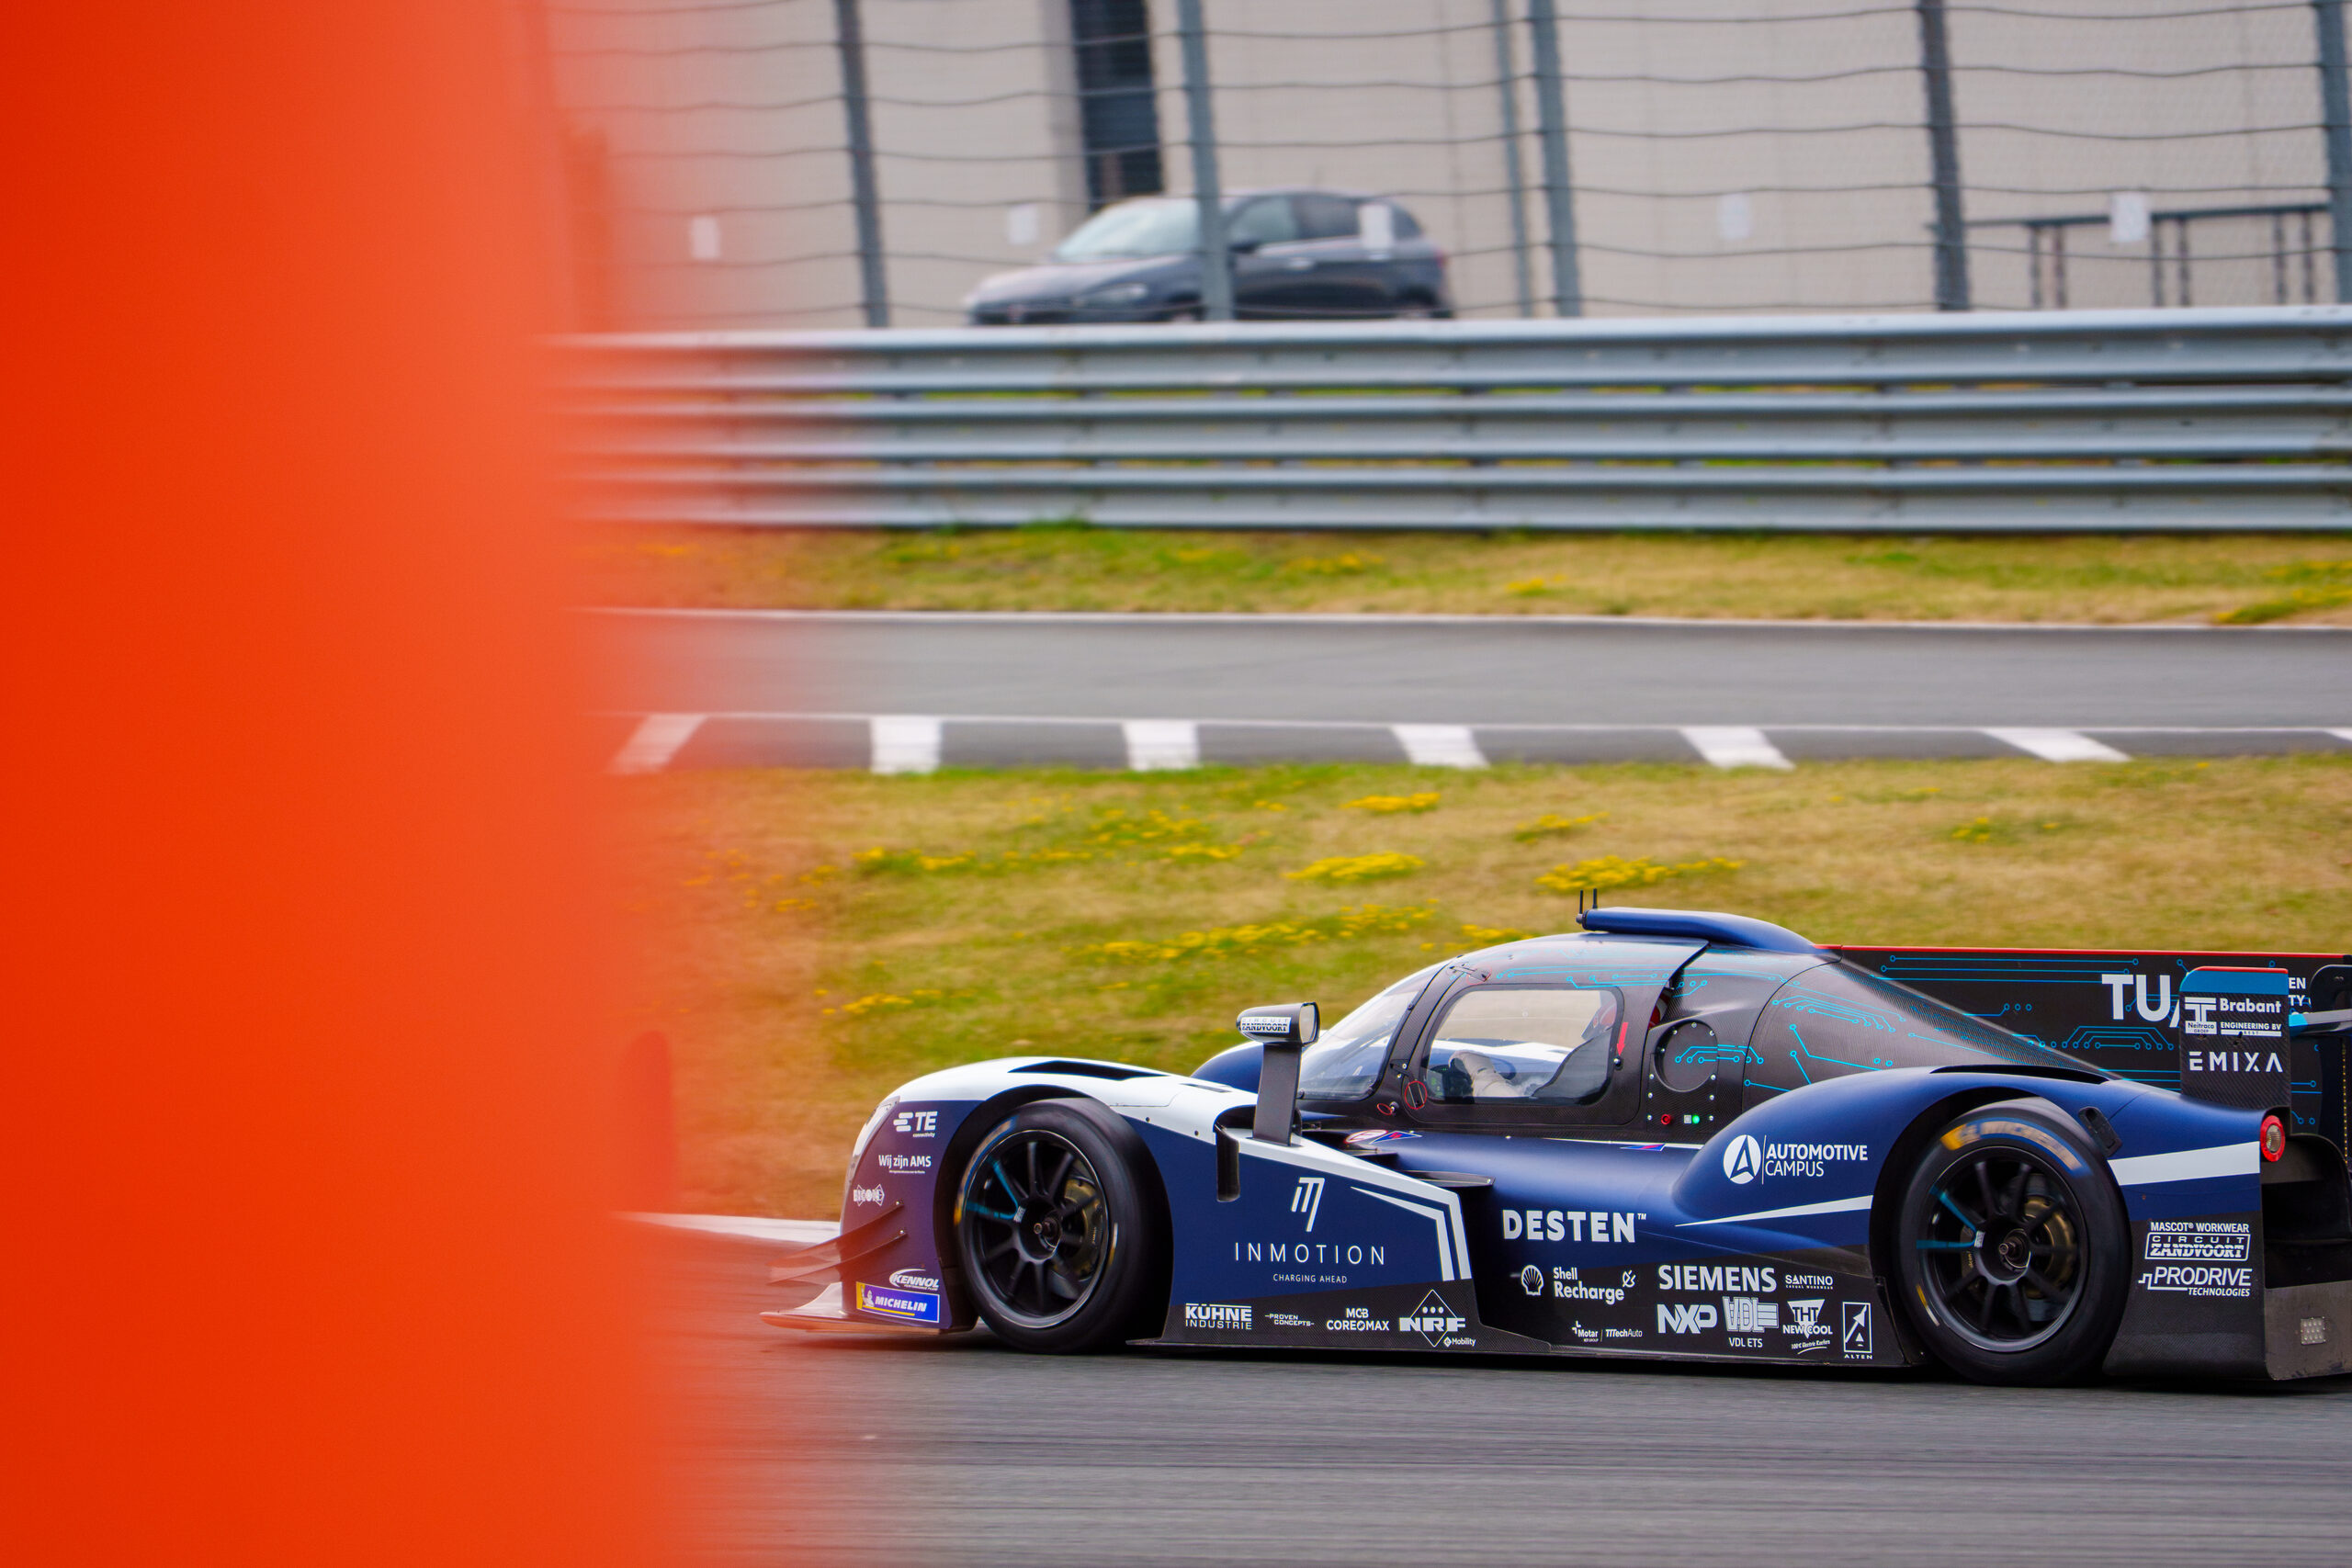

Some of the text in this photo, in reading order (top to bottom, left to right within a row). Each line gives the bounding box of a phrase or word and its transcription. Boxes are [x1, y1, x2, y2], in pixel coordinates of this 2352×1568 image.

[2220, 998, 2281, 1013] Brabant
[2220, 1021, 2269, 1030] ENGINEERING
[2188, 1051, 2283, 1073] EMIXA
[914, 1111, 938, 1132] TE
[1765, 1144, 1869, 1161] AUTOMOTIVE
[878, 1154, 932, 1169] Wij zijn AMS
[1764, 1160, 1825, 1177] CAMPUS
[2195, 1223, 2250, 1233] WORKWEAR
[2152, 1235, 2245, 1244] CIRCUIT
[1235, 1242, 1385, 1265] INMOTION
[2150, 1243, 2245, 1258] ZANDVOORT
[891, 1274, 939, 1288] KENNOL
[1272, 1273, 1348, 1283] CHARGING AHEAD
[1553, 1267, 1577, 1280] Shell
[1657, 1264, 1778, 1293] SIEMENS
[1785, 1274, 1834, 1286] SANTINO
[2154, 1267, 2253, 1286] PRODRIVE
[1555, 1280, 1624, 1305] Recharge
[2188, 1288, 2251, 1297] TECHNOLOGIES
[875, 1296, 928, 1313] MICHELIN
[1346, 1308, 1369, 1319] MCB
[1657, 1303, 1718, 1335] NXP
[1722, 1296, 1765, 1333] VDL
[1792, 1306, 1819, 1322] THT
[1185, 1319, 1252, 1330] INDUSTRIE
[1399, 1317, 1466, 1332] NRF
[1782, 1325, 1834, 1336] NEW COOL
[1728, 1337, 1763, 1348] VDL ETS
